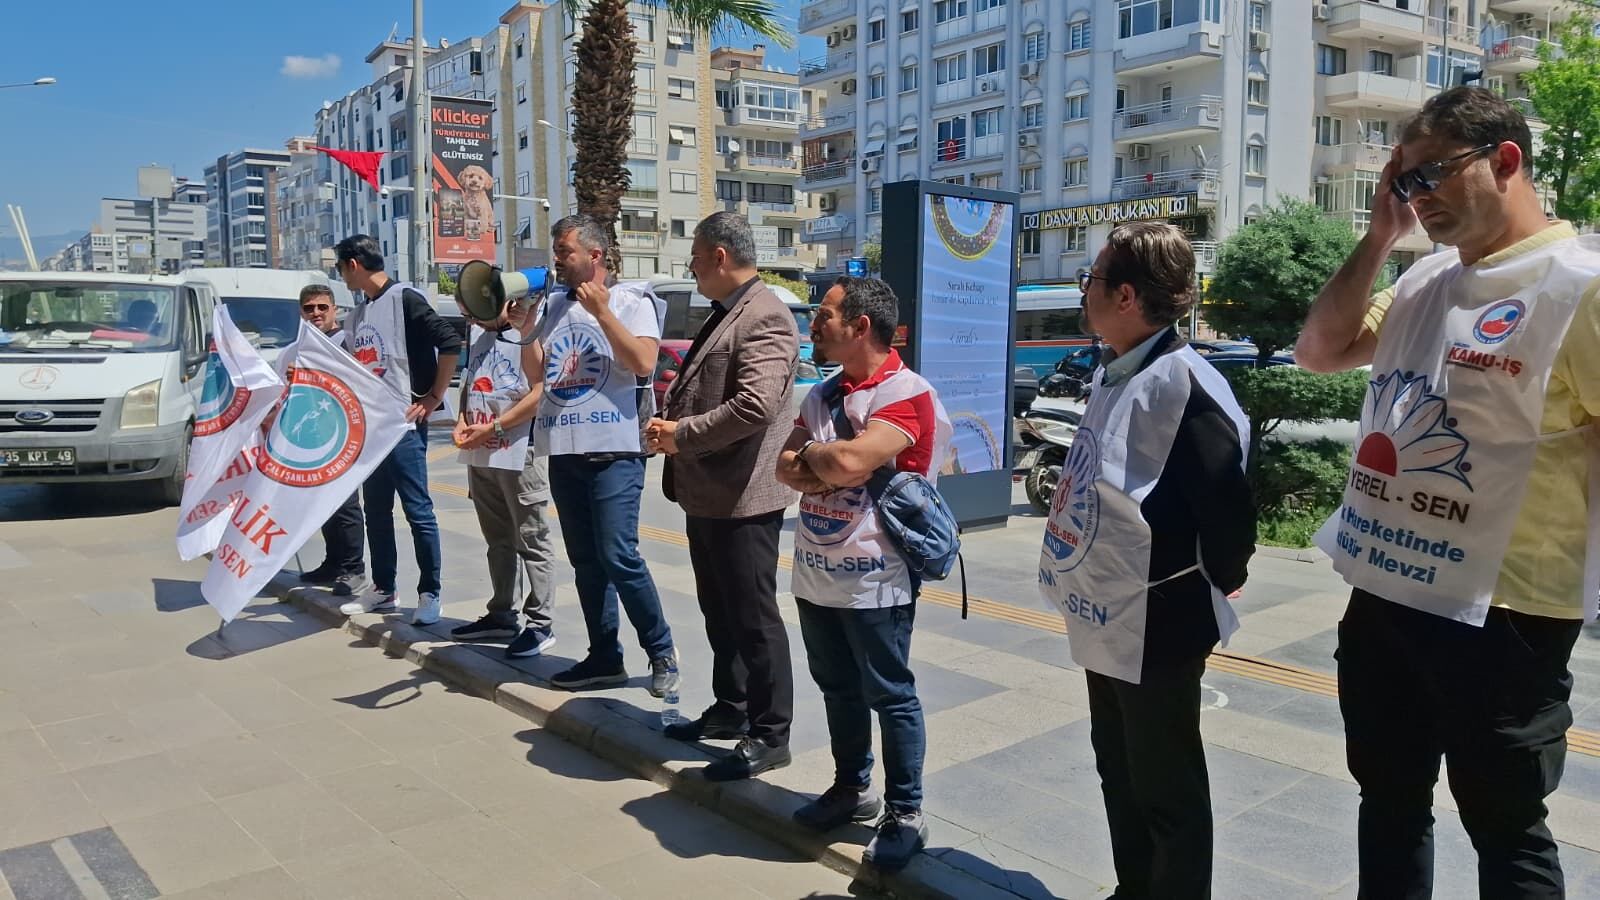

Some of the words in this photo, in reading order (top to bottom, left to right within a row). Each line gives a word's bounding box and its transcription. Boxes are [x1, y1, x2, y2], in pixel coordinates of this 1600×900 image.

[432, 107, 489, 126] Klicker
[445, 136, 480, 147] TAHILSIZ
[441, 150, 485, 161] GLÜTENSİZ
[1044, 213, 1091, 228] DAMLA
[1093, 203, 1160, 223] DURUKAN
[1448, 345, 1523, 378] KAMU-İŞ
[560, 410, 621, 426] BEL-SEN
[5, 450, 20, 463] 35
[27, 450, 49, 463] KPT
[57, 450, 72, 463] 49
[1350, 467, 1390, 503] YEREL
[1410, 491, 1470, 524] SEN
[812, 504, 854, 520] BEL-SEN
[810, 518, 830, 530] 1990
[805, 550, 886, 572] BEL-SEN
[1367, 546, 1437, 585] Mevzi
